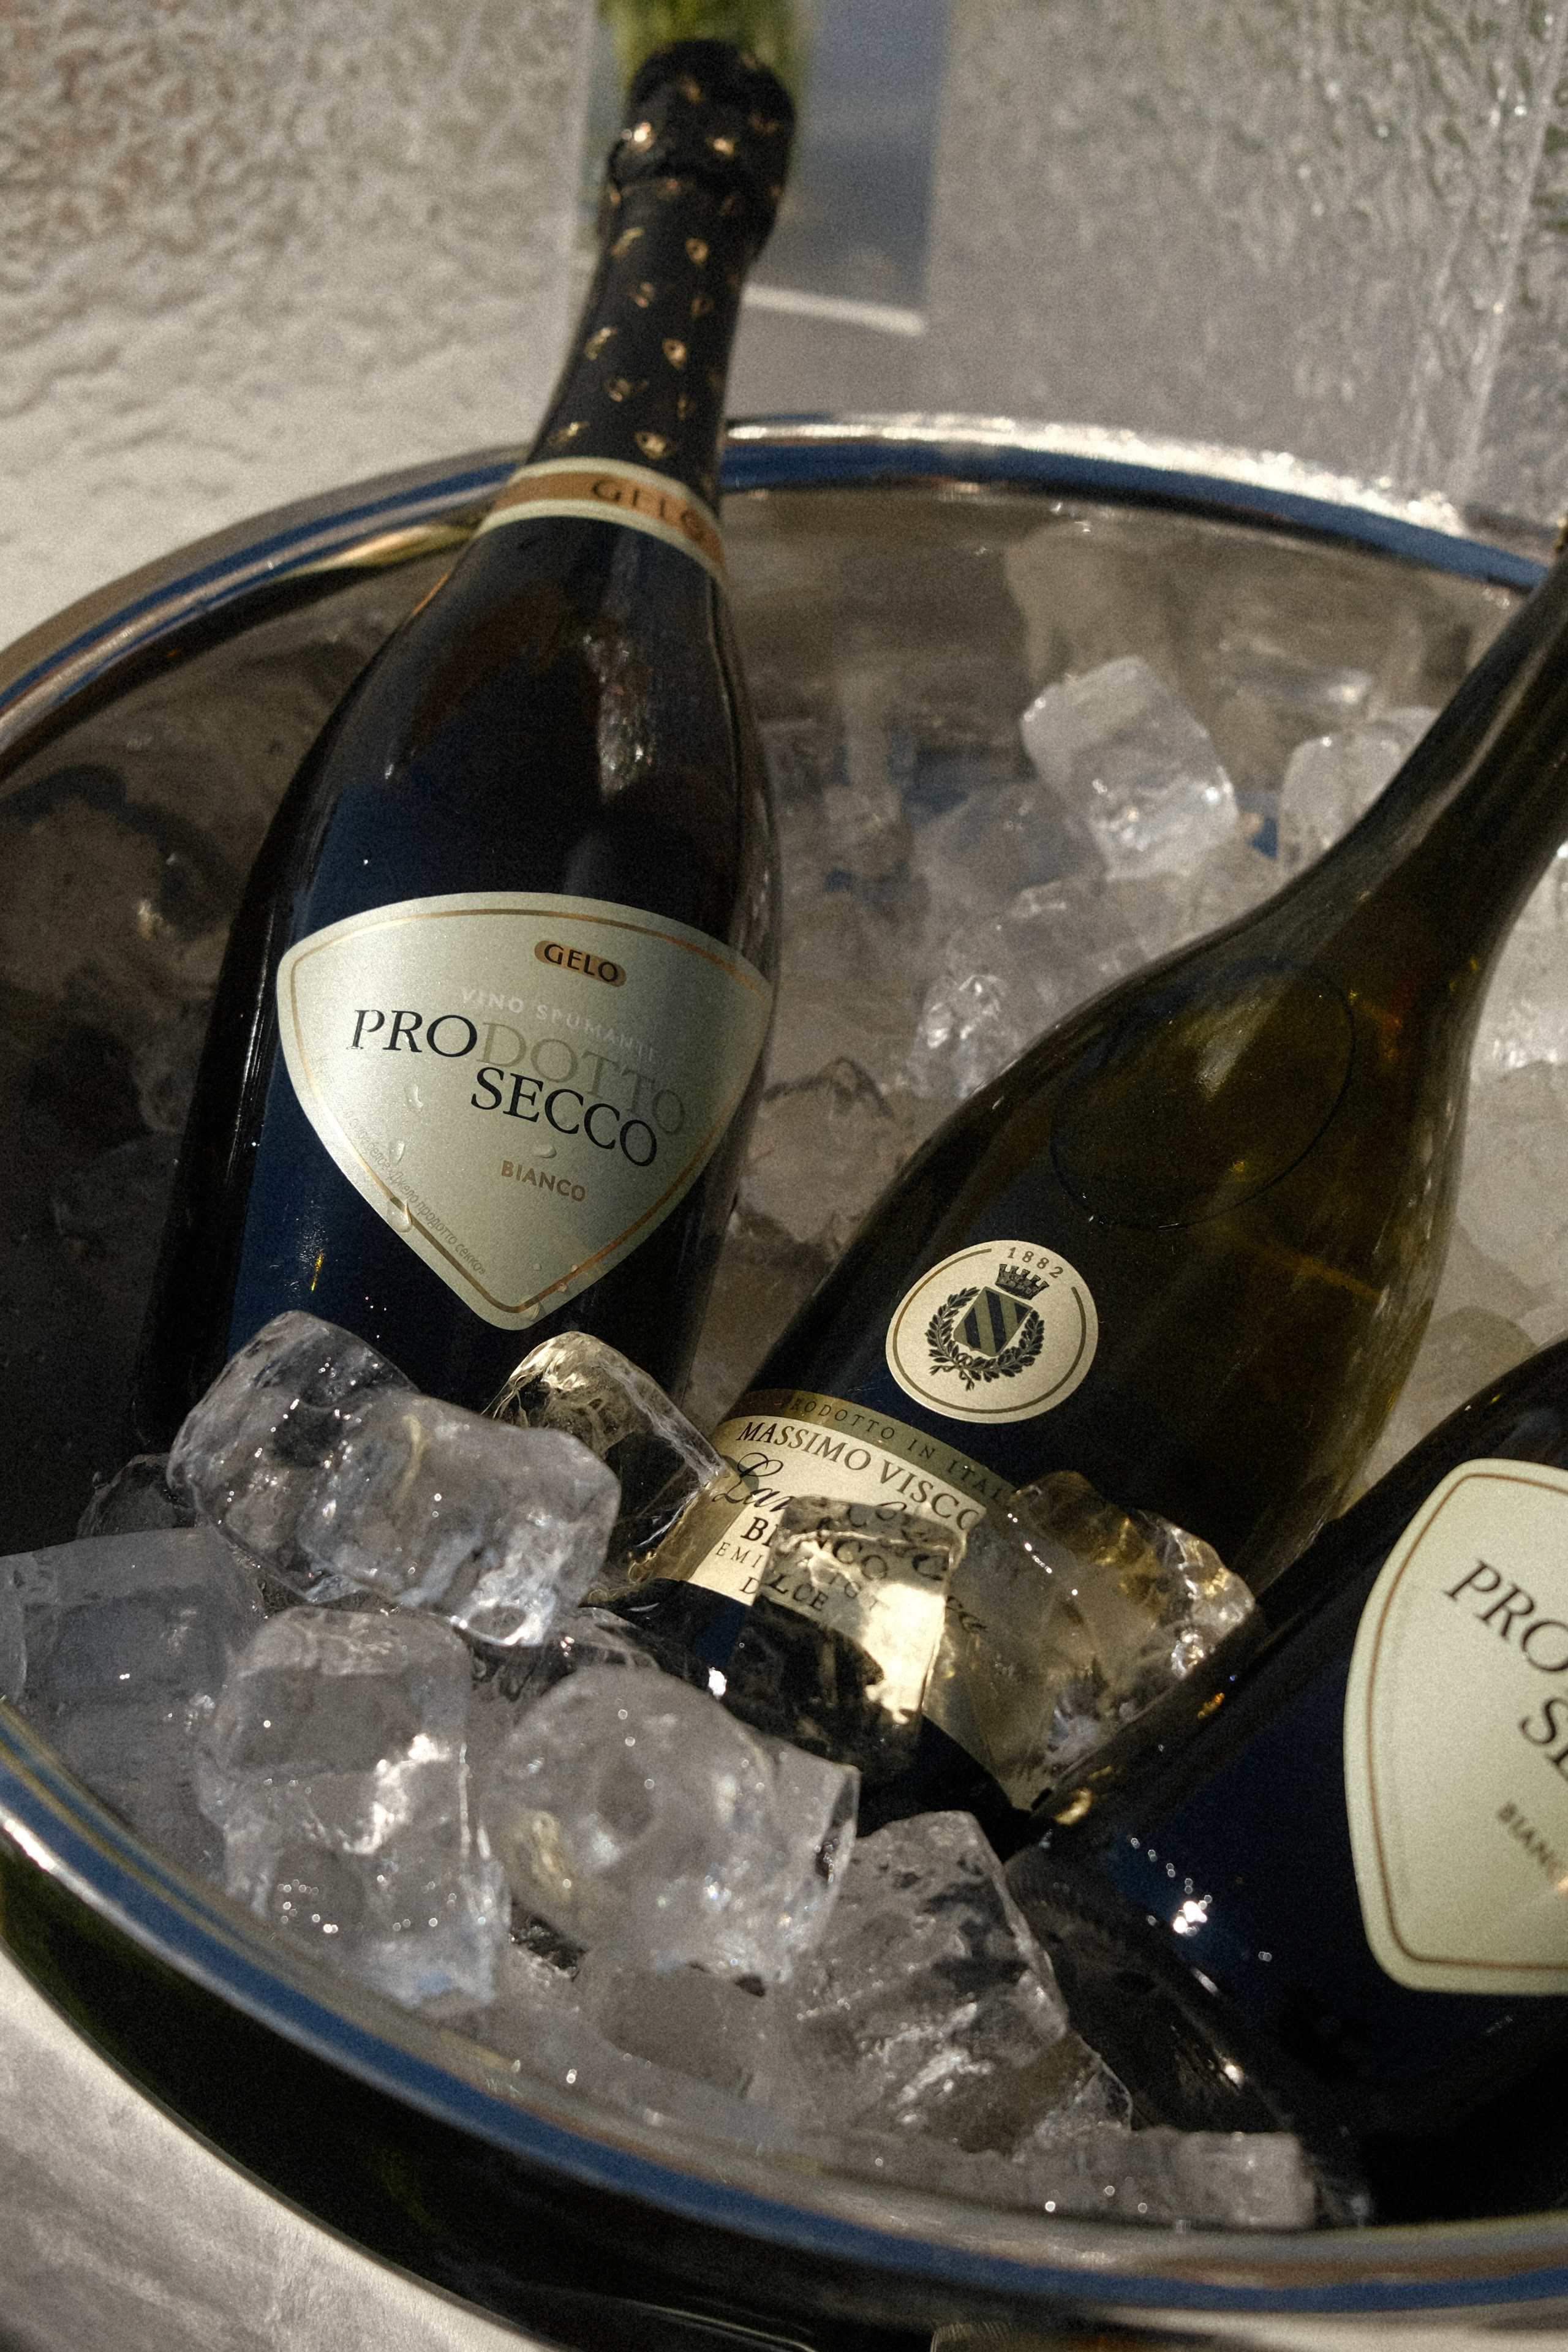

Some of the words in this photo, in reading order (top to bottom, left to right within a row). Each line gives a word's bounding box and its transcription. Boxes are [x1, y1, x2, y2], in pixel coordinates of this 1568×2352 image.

[544, 943, 618, 982] GELO
[461, 987, 524, 1014] VINO
[470, 1066, 658, 1167] SECCO
[501, 1159, 586, 1202] BIANCO
[416, 1200, 458, 1245] продотто
[455, 1243, 486, 1275] секко»
[1007, 1246, 1064, 1279] 1882
[736, 1421, 872, 1471] MASSIMO
[907, 1438, 937, 1460] IN
